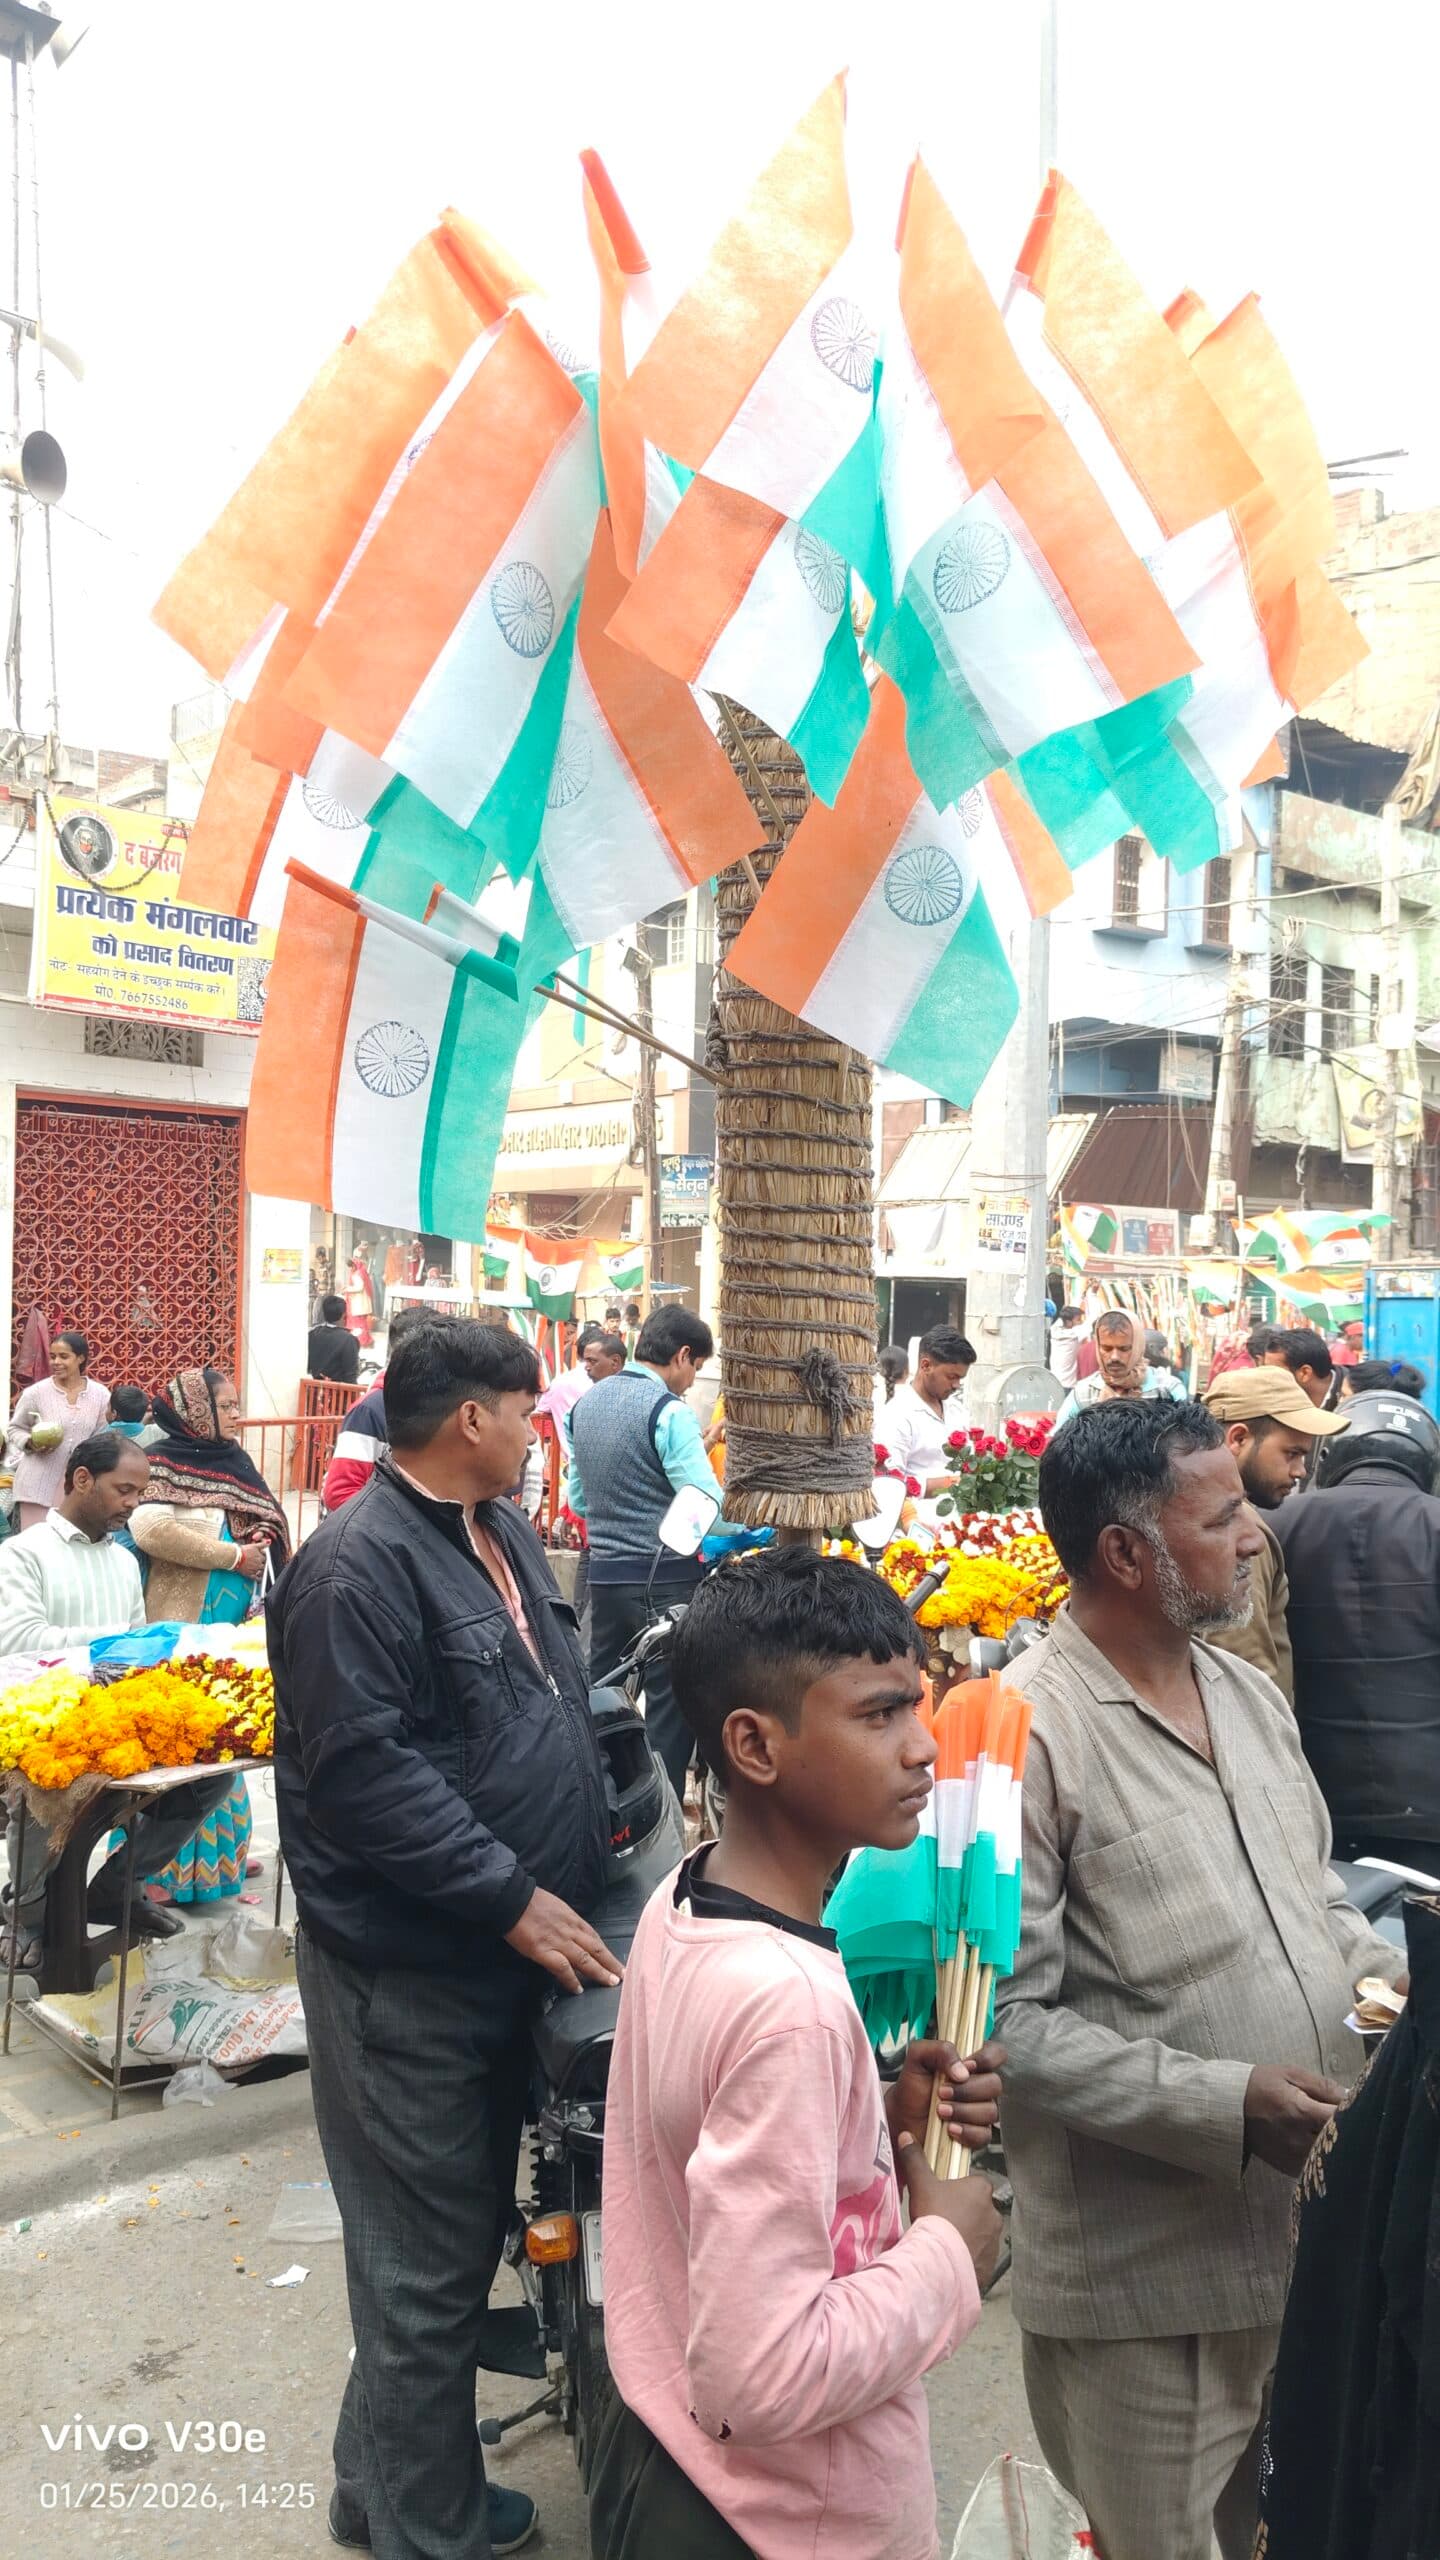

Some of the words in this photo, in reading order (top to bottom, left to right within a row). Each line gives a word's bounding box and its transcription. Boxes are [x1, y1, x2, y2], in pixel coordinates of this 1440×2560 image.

[56, 885, 137, 924] प्रत्येक
[145, 896, 260, 946] मंगलवार
[92, 933, 118, 957] को
[123, 942, 172, 965] प्रसाद
[178, 943, 235, 976] वितरण
[120, 989, 189, 1010] 7667552486
